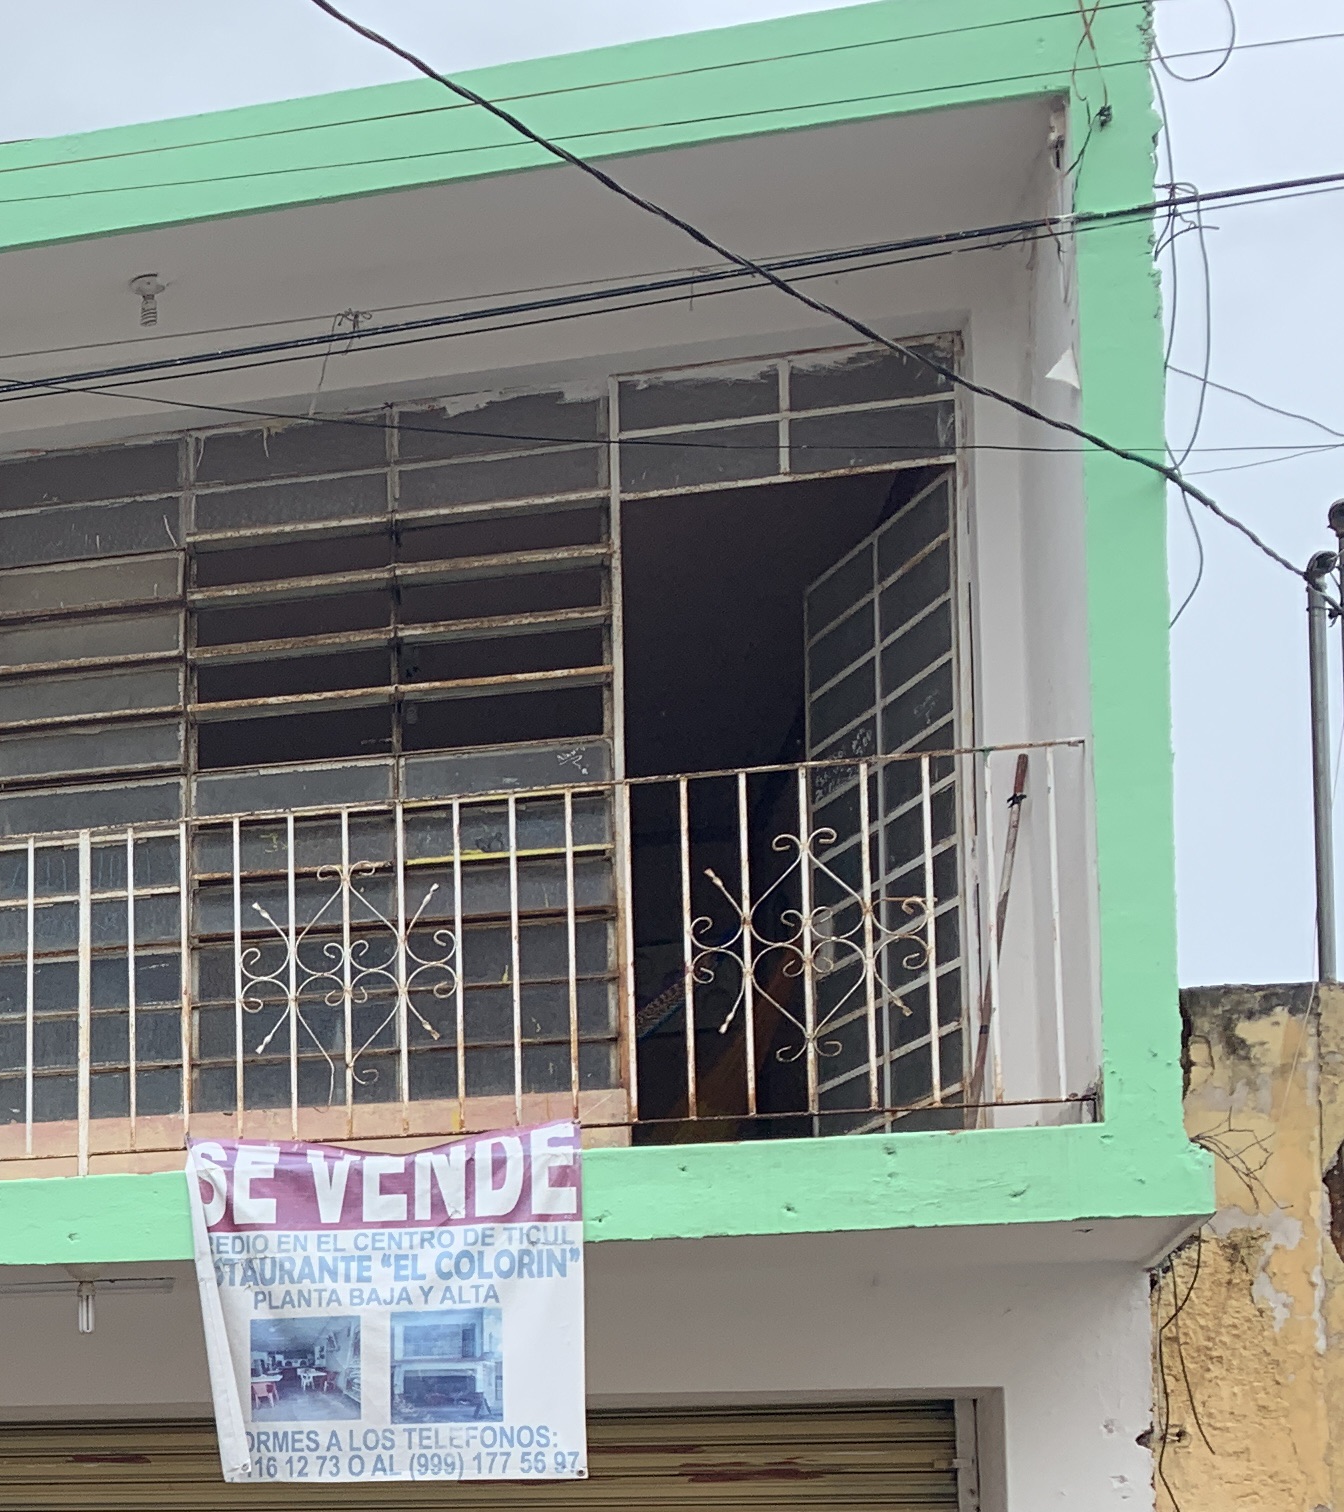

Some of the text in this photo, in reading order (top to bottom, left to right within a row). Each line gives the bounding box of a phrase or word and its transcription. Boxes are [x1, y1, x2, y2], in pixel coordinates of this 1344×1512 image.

[188, 1122, 578, 1228] SE VENDE
[209, 1224, 576, 1255] EDIO EN EL CENTRO DE TICUL
[253, 1284, 500, 1310] PLANTA BAJA Y ALTA
[326, 1429, 343, 1452] A
[349, 1428, 396, 1452] LOS
[403, 1425, 558, 1450] TELEFONOS:
[285, 1456, 309, 1478] 12
[316, 1455, 341, 1478] 73
[370, 1453, 402, 1477] AL
[409, 1451, 464, 1481] (999)
[472, 1451, 512, 1475] 177
[519, 1451, 547, 1474] 56
